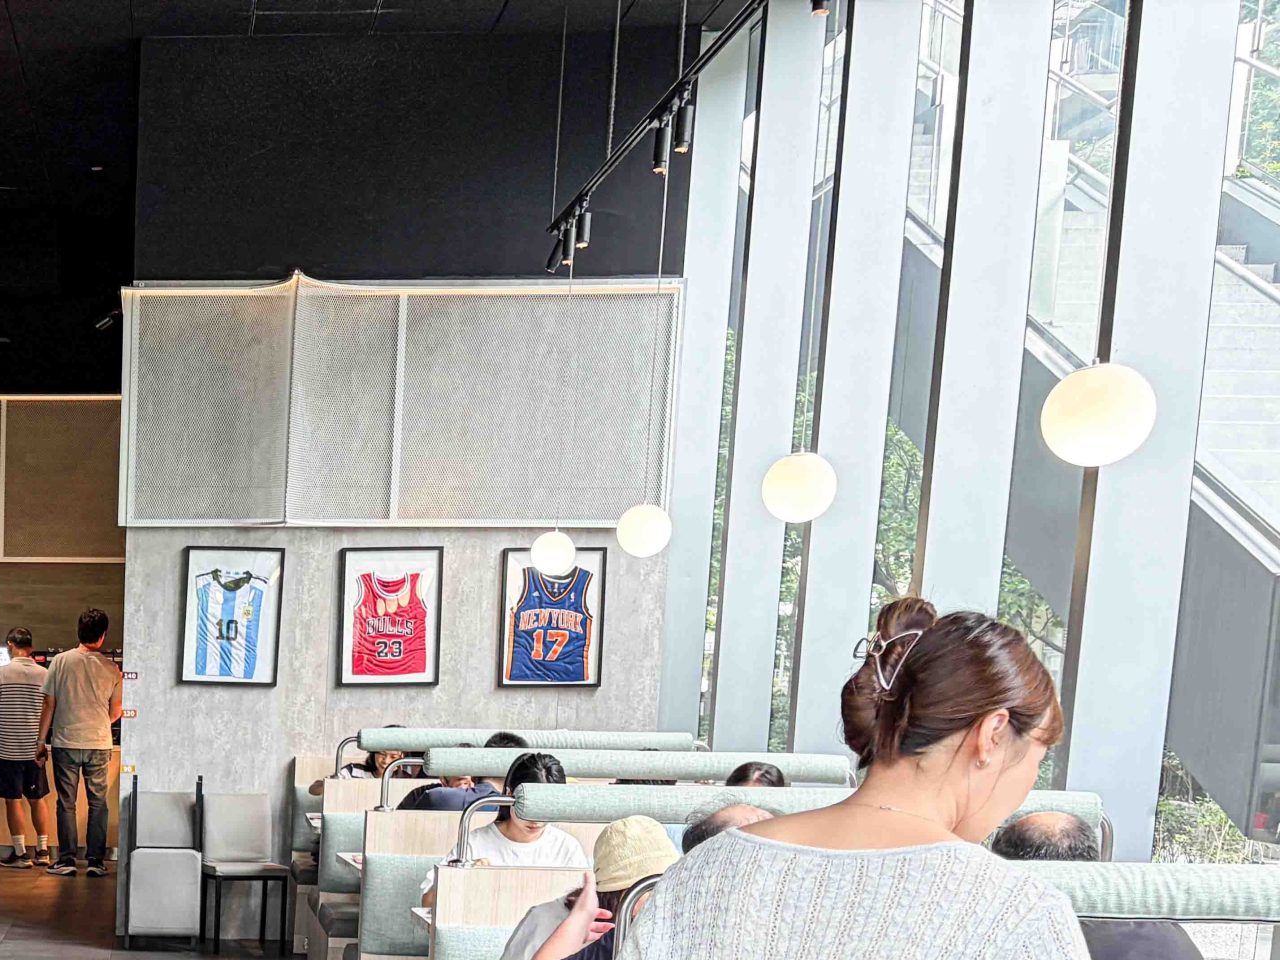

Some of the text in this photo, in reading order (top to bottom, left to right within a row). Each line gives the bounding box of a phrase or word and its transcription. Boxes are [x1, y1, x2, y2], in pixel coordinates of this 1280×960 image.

[216, 619, 238, 640] 10
[367, 616, 413, 636] BULLS
[519, 608, 583, 634] NEW YORK
[376, 640, 403, 659] 23
[532, 629, 569, 661] 17
